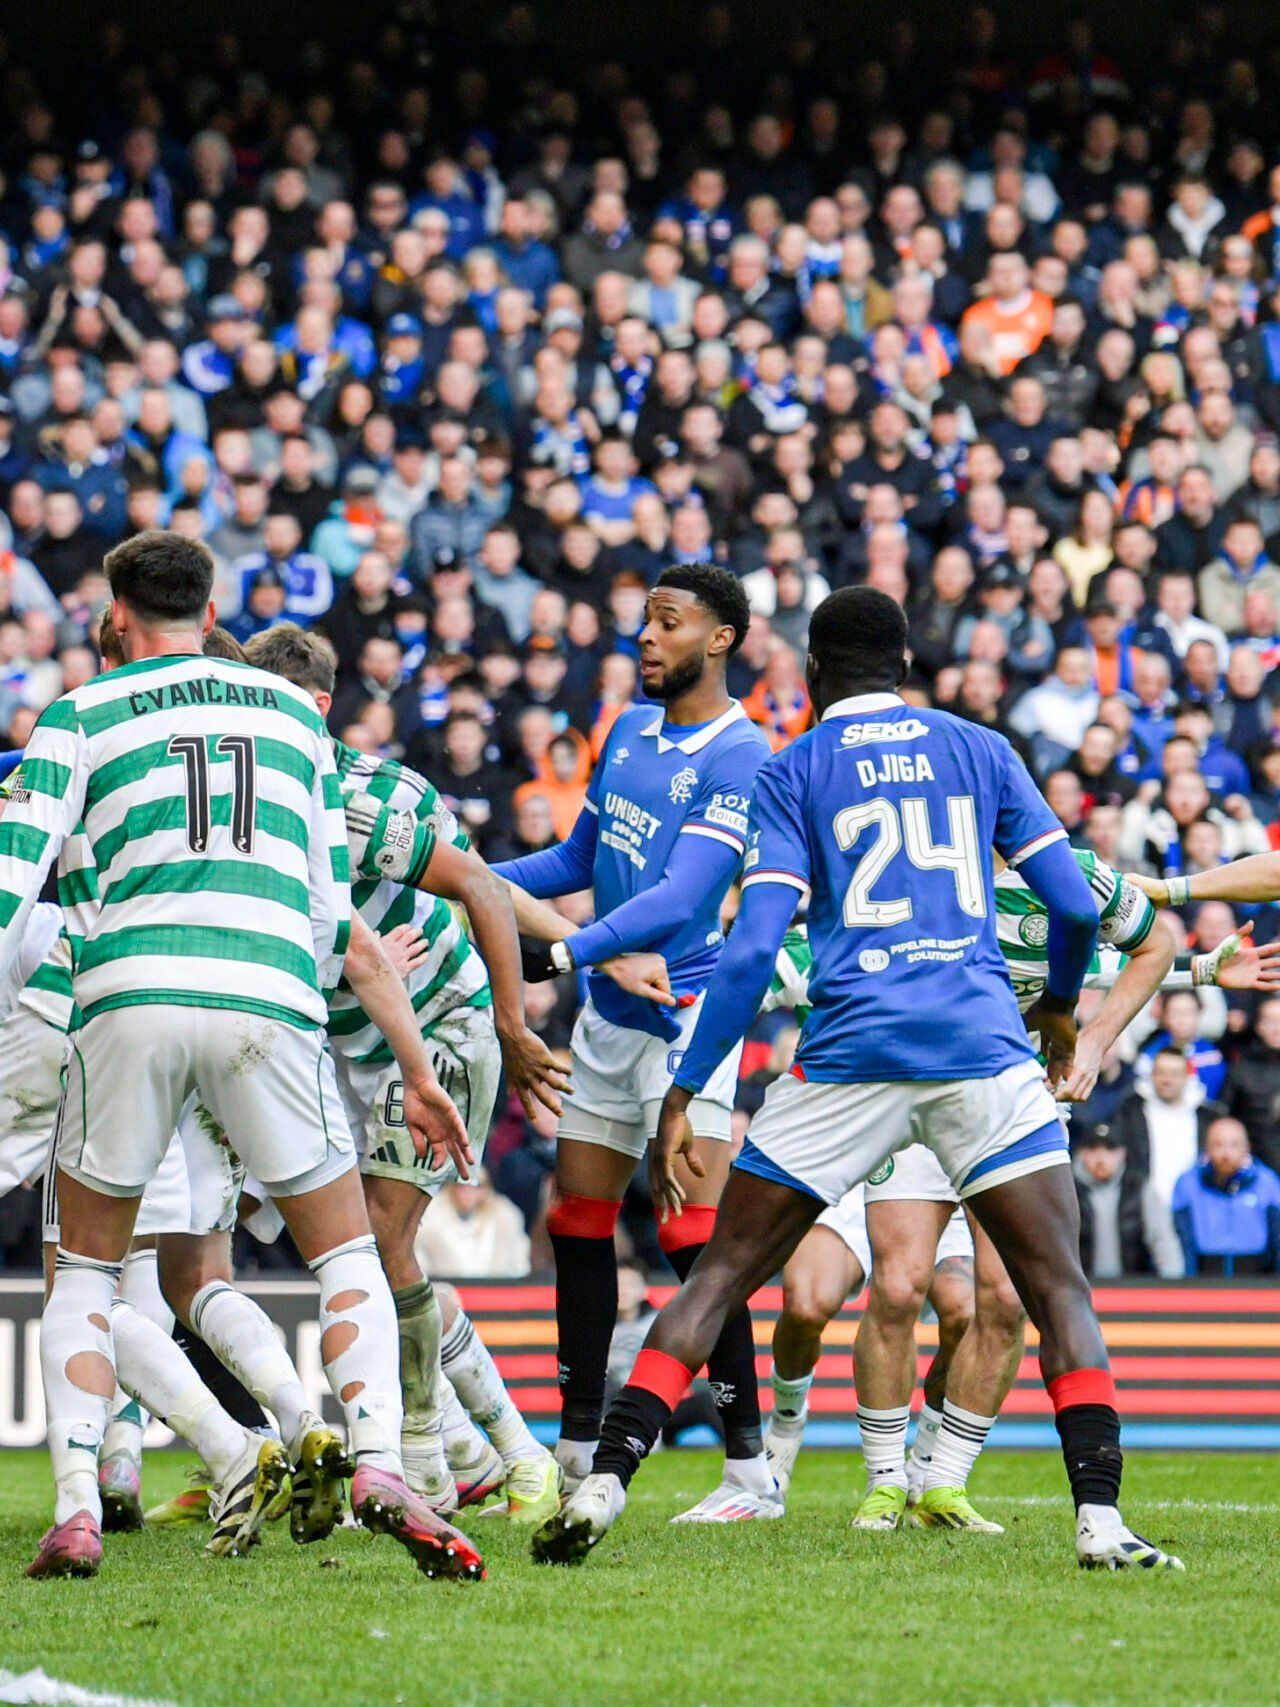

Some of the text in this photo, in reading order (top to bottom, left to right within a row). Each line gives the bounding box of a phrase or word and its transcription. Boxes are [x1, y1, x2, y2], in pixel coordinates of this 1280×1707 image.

[128, 673, 279, 716] ČVANČARA
[839, 719, 930, 746] SEKO
[855, 753, 936, 789] DJIGA
[166, 733, 258, 857] 11
[604, 791, 662, 840] UNIBET
[833, 795, 988, 929] 24
[889, 934, 979, 955] PIPELINE ENERGY
[906, 949, 965, 963] SOLUTIONS
